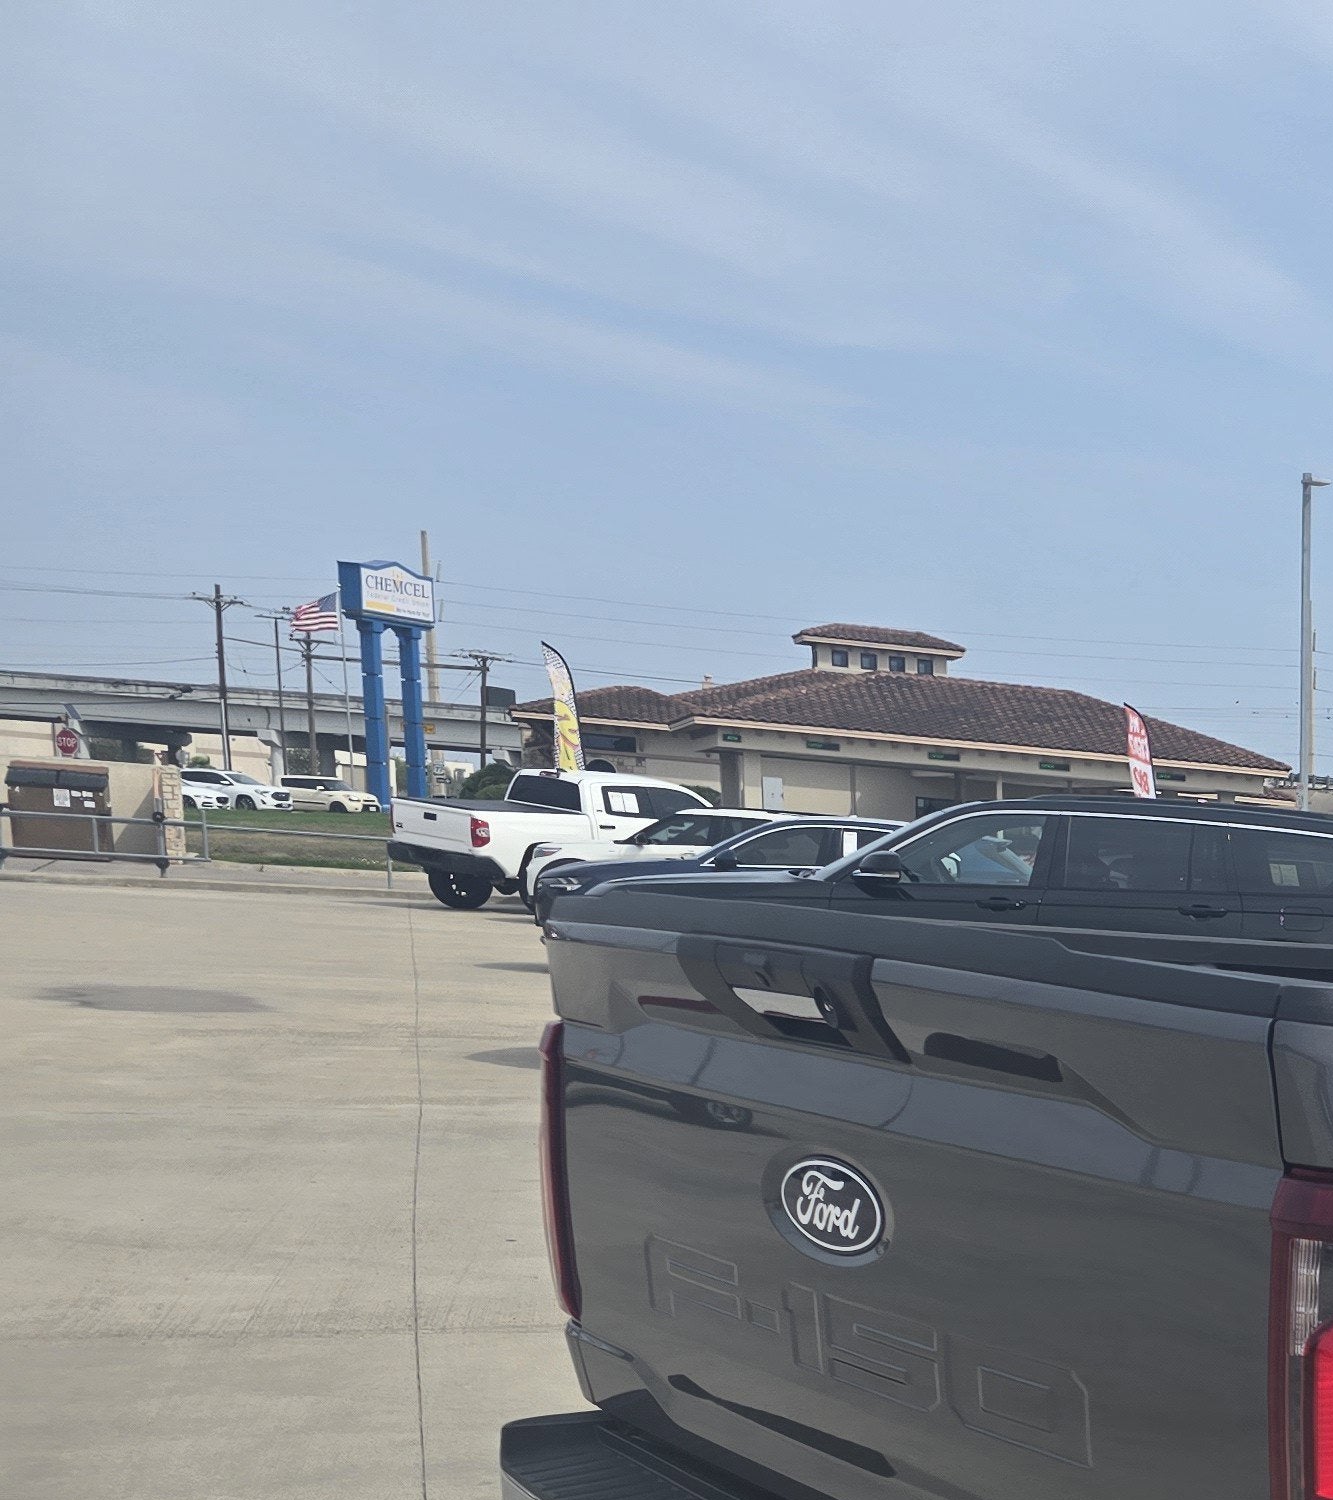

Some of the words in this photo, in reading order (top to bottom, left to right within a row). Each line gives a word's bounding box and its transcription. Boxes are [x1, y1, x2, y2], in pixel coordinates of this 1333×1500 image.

[365, 574, 430, 599] CHEMCEL
[57, 736, 78, 748] STOP
[796, 1170, 861, 1239] Ford
[644, 1232, 1094, 1468] F-150
